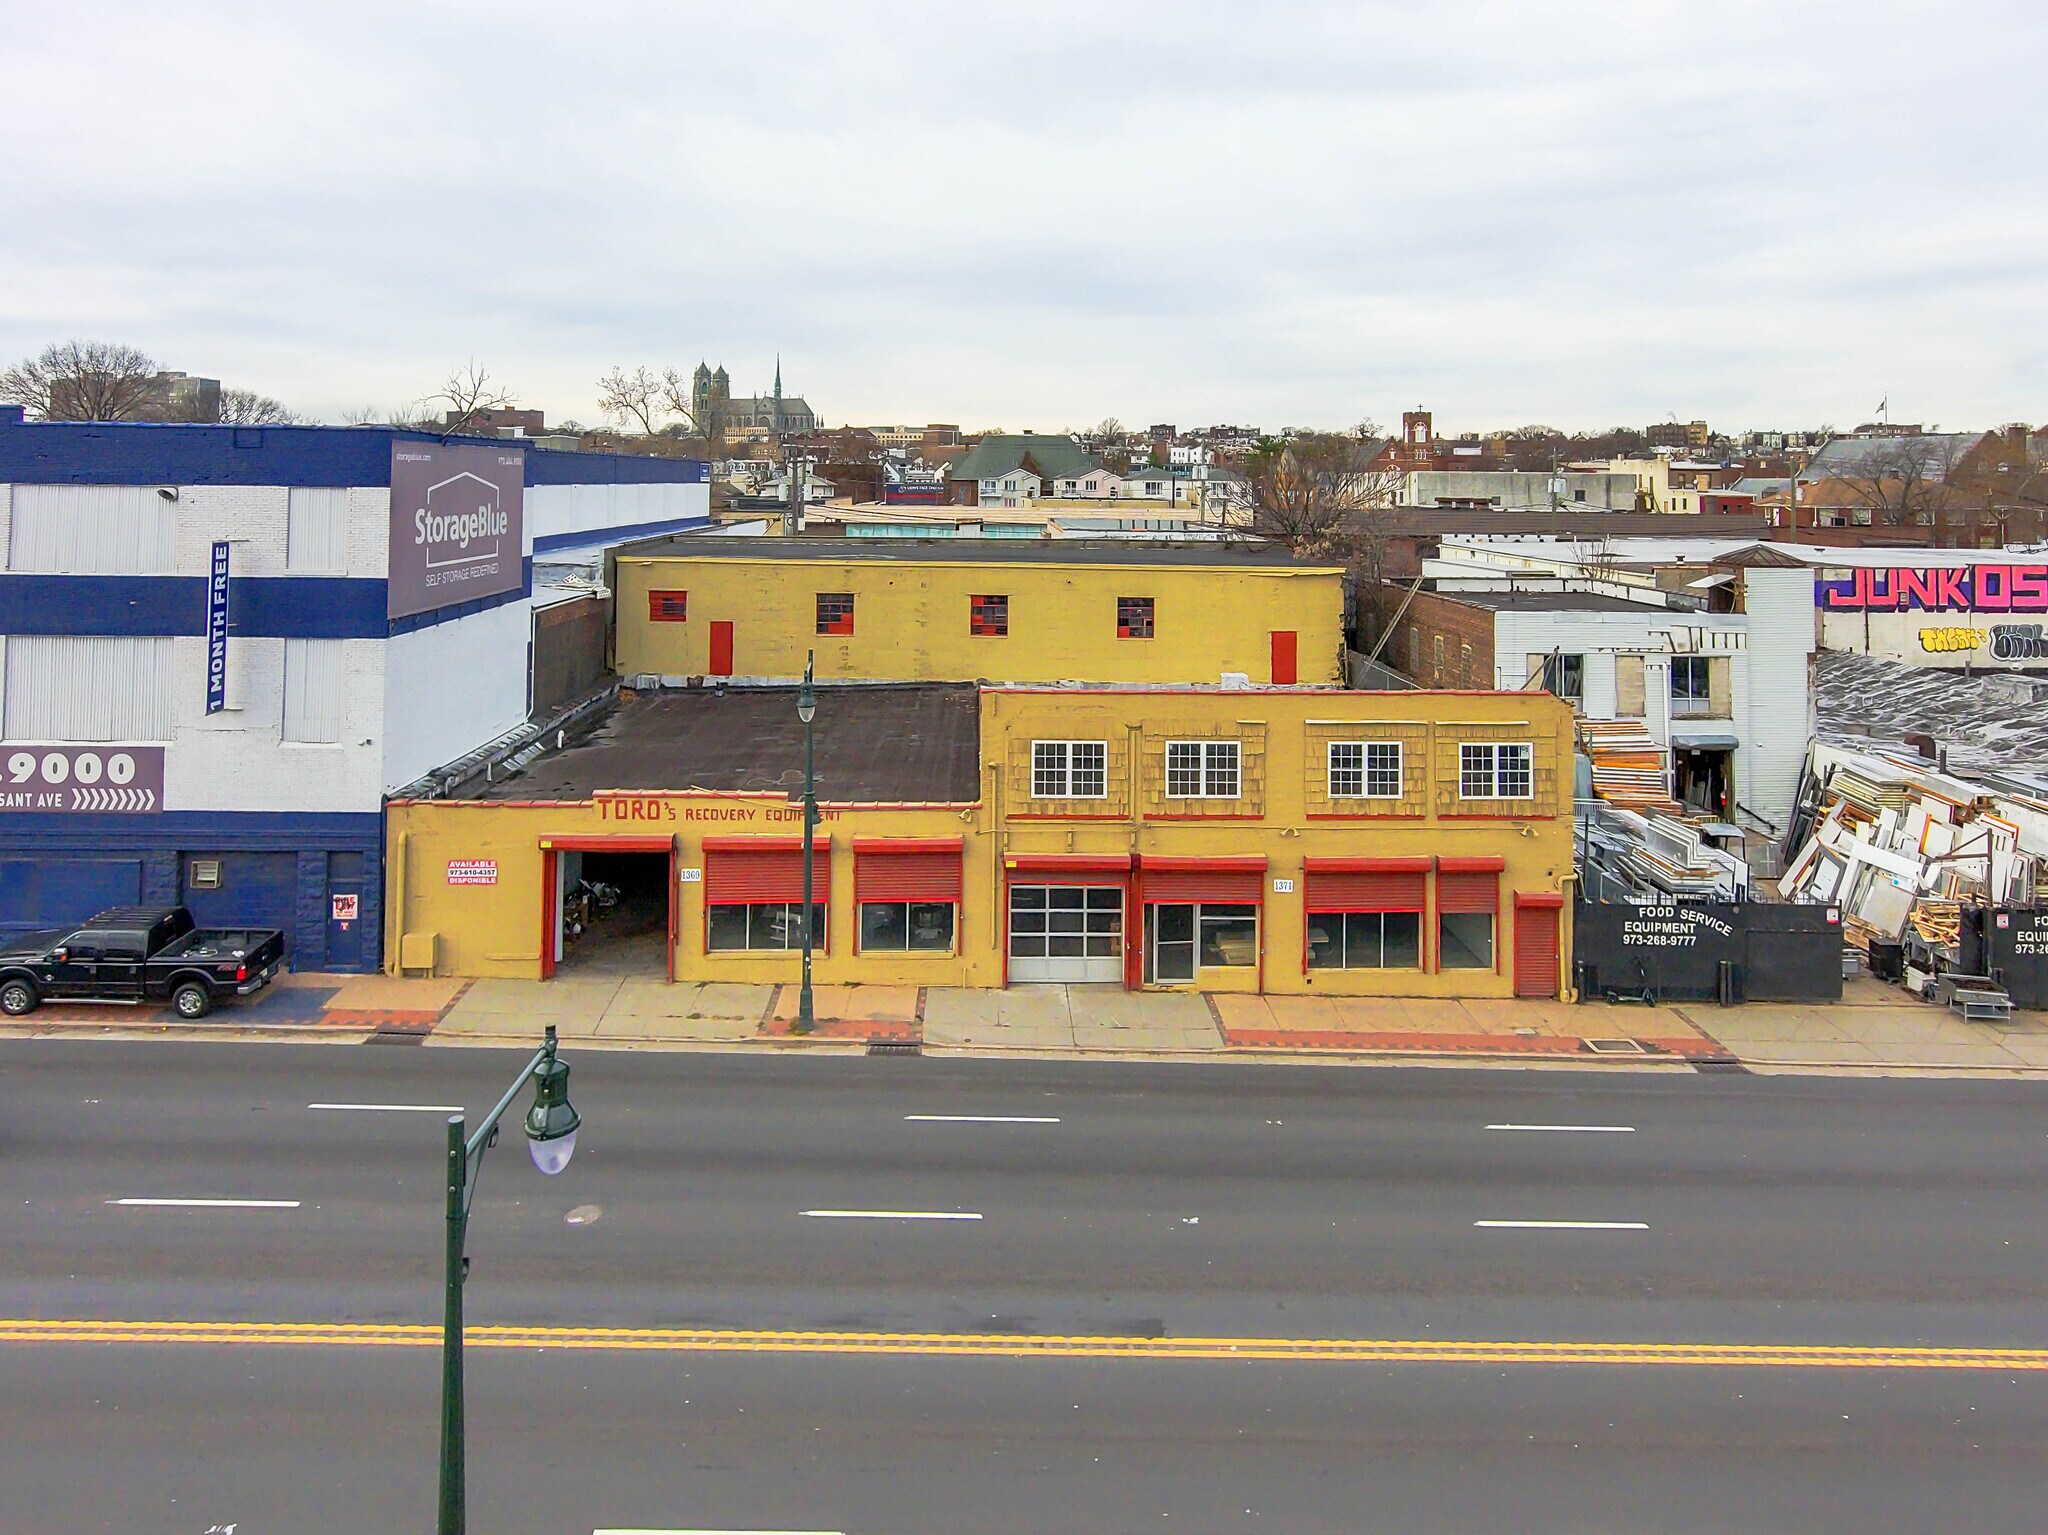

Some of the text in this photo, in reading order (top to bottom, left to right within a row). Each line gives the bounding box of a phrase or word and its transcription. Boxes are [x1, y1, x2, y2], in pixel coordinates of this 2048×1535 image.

[415, 503, 508, 549] StorageBlue
[425, 573, 441, 587] SELF
[442, 563, 470, 584] STORAGE
[210, 546, 227, 711] 1 MONTH FREE
[37, 793, 62, 807] AVE
[685, 808, 756, 821] RECOVERY
[1275, 881, 1291, 890] 1371
[1624, 921, 1697, 934] EQUIPMENT
[1639, 906, 1733, 937] FOOD SERVICE
[1622, 934, 1697, 946] 973-268-9777
[2017, 931, 2048, 942] EQUI
